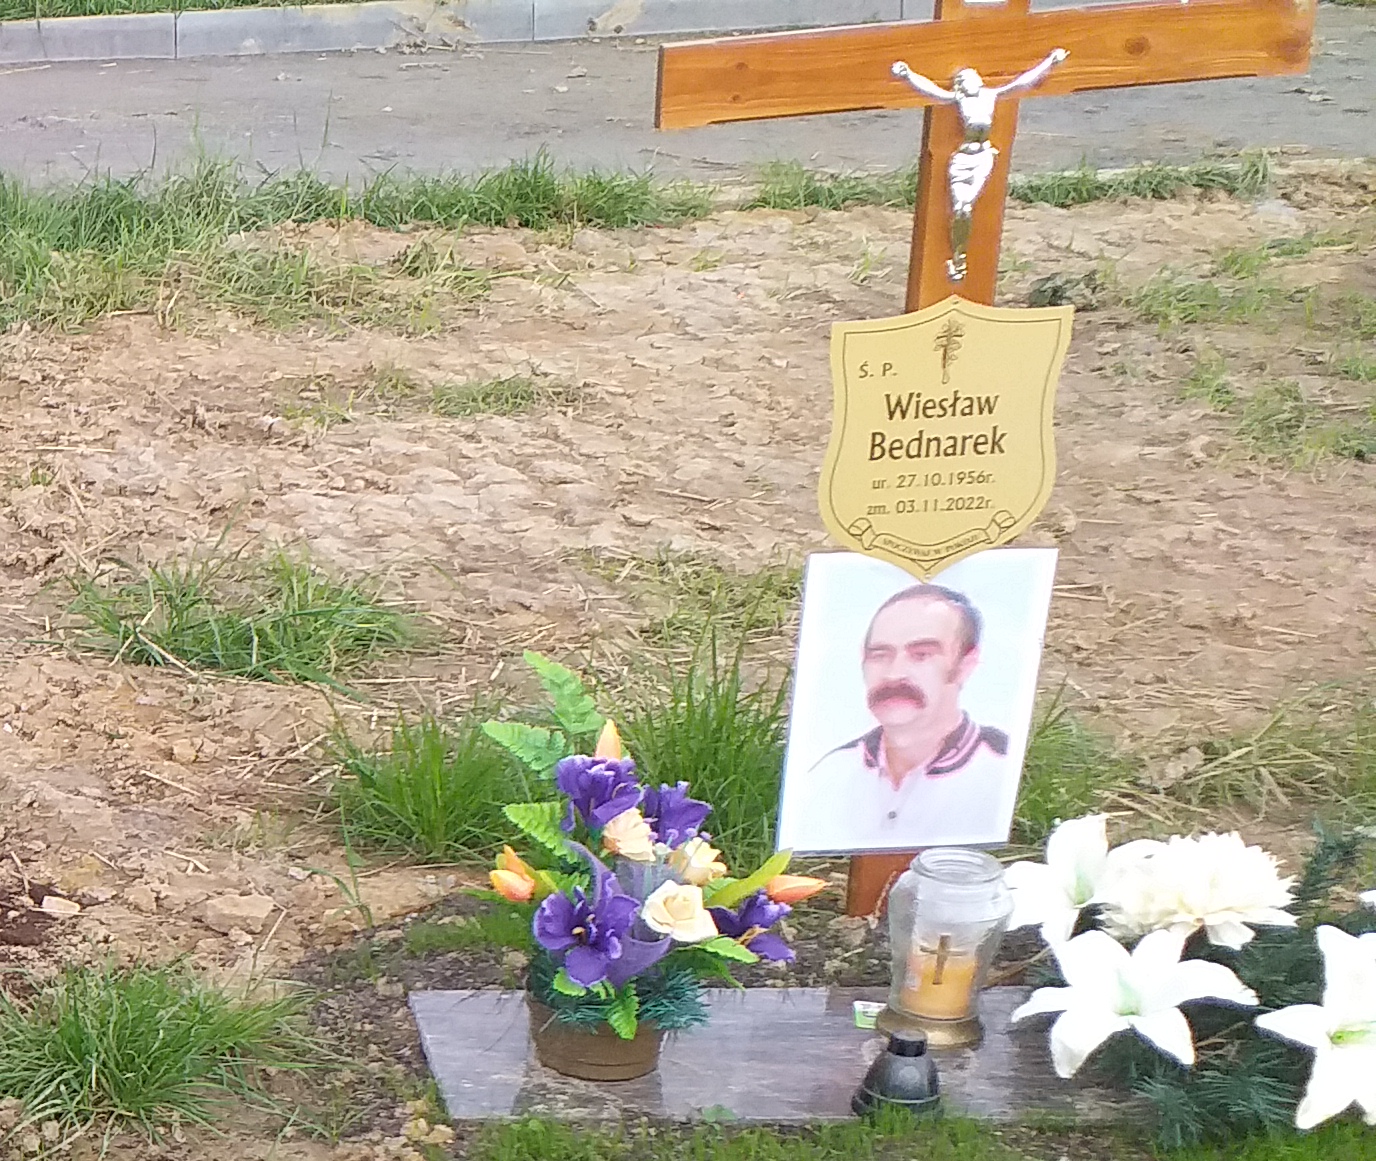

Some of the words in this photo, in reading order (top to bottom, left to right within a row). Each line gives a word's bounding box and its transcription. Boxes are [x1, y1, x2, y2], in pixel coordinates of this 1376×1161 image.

[884, 389, 1000, 421] Wiesław
[868, 425, 1008, 461] Bednarek
[872, 478, 891, 490] ur.
[896, 469, 996, 489] 27.10.1956r.
[866, 504, 890, 515] zm.
[896, 495, 996, 514] 03.11.2022r.
